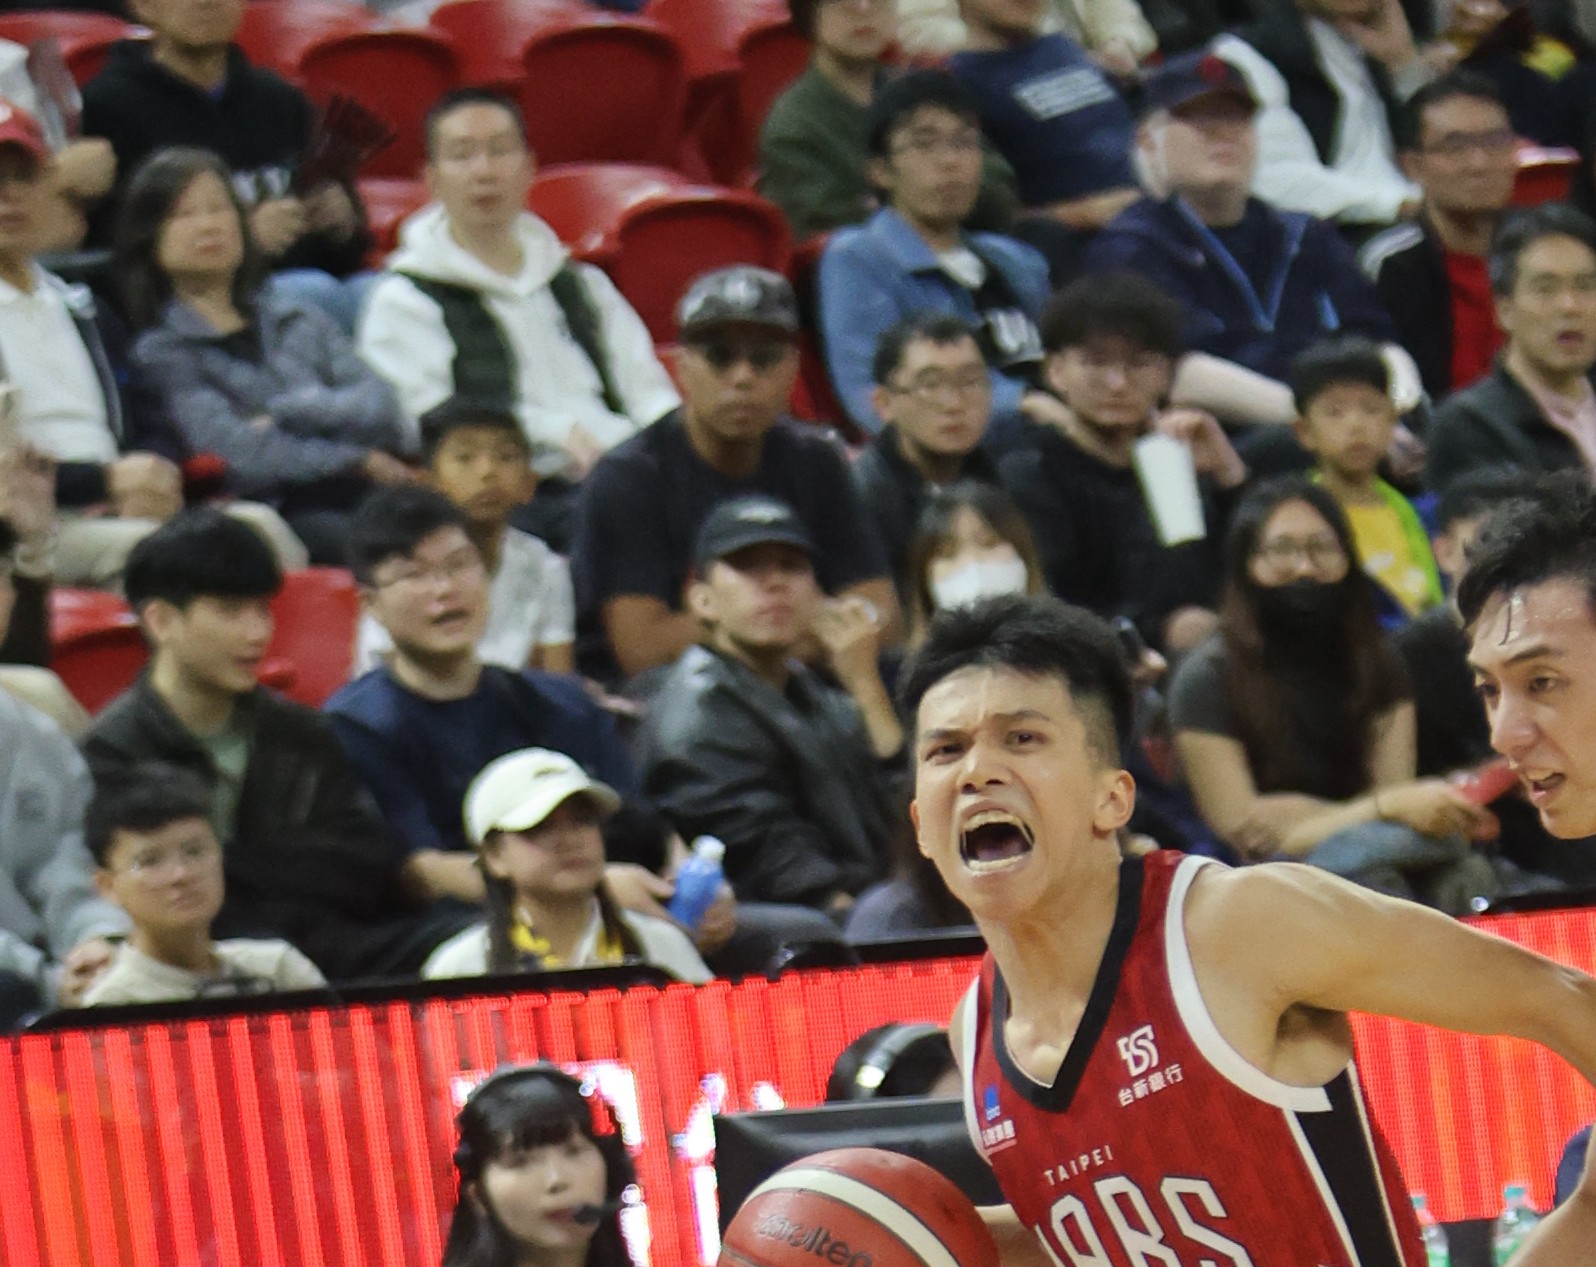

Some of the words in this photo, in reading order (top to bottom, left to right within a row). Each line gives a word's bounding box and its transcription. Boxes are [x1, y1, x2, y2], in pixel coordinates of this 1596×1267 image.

[1118, 1063, 1183, 1107] 台新銀行
[1043, 1144, 1114, 1186] TAIPEI
